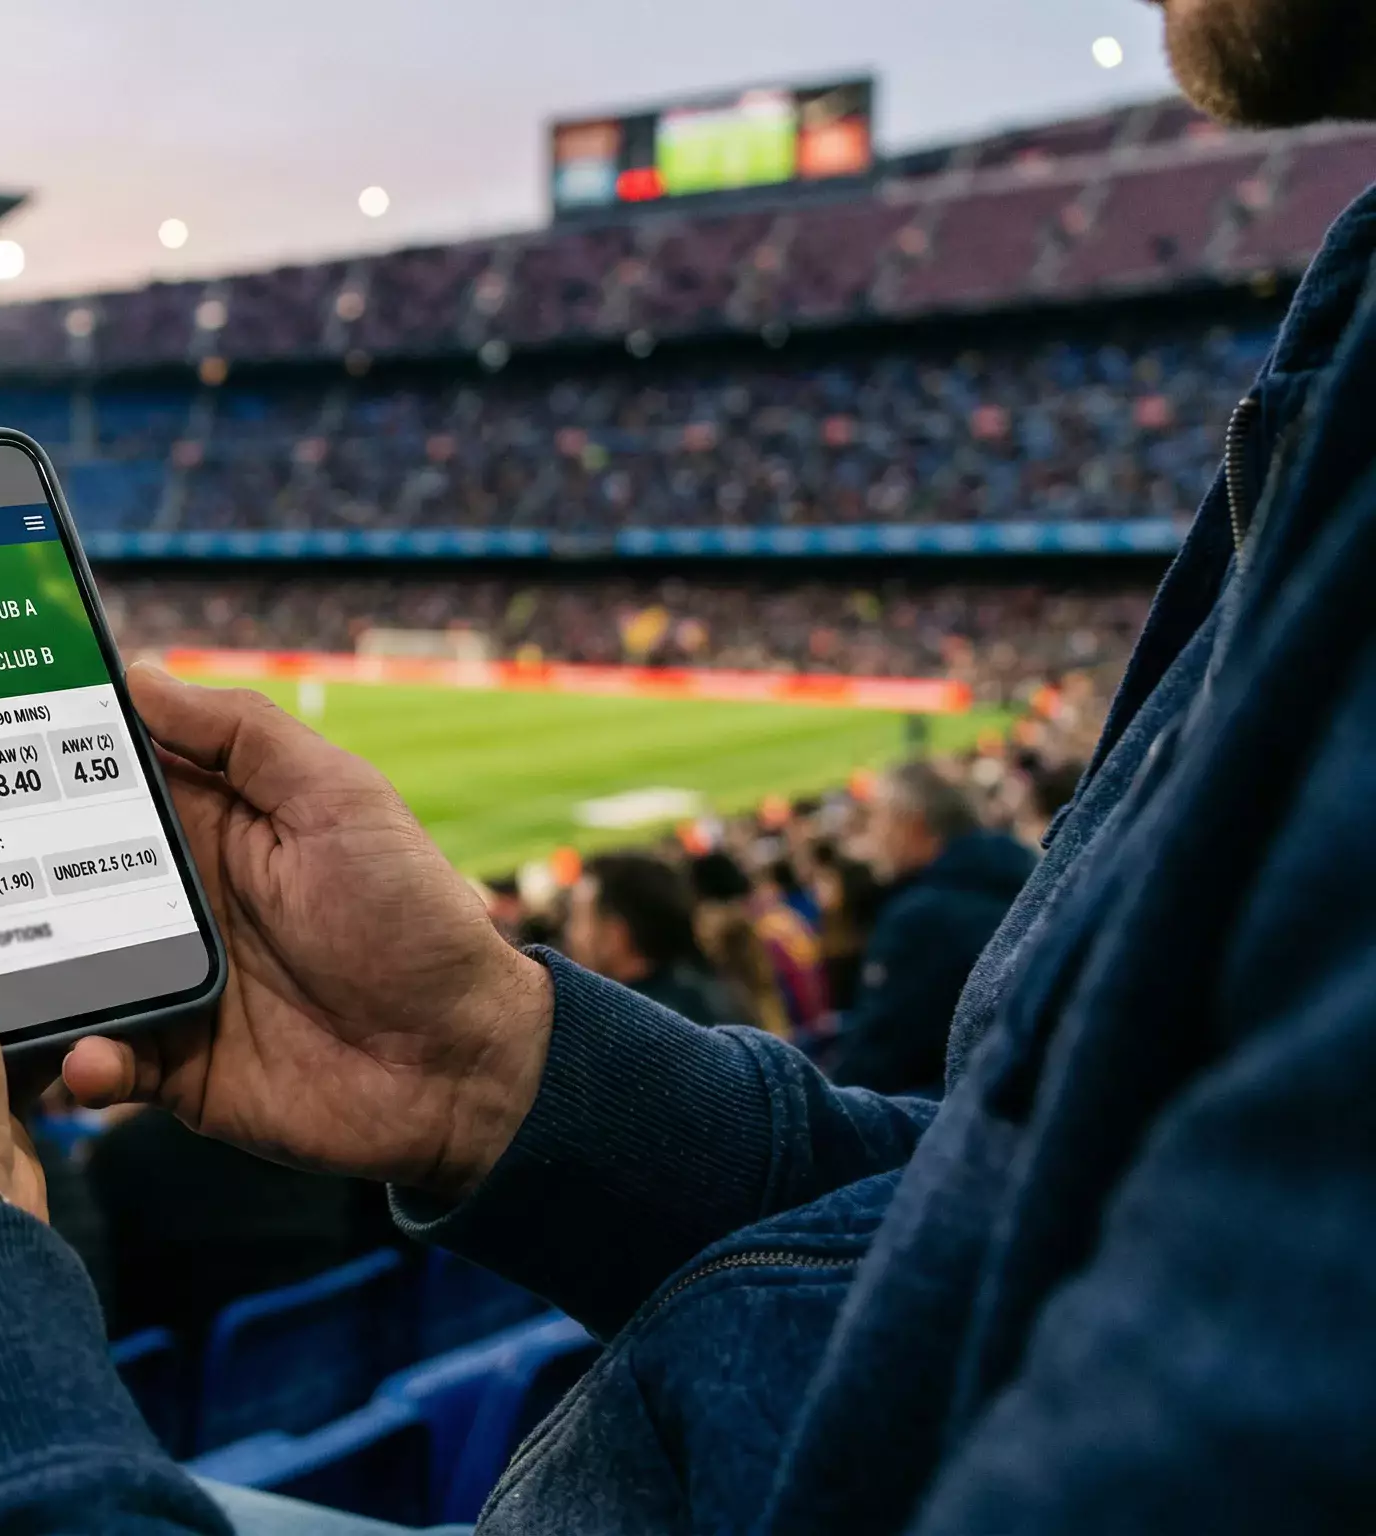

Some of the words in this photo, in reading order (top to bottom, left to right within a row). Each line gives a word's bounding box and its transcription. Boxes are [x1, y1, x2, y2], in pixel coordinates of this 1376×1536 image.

[26, 599, 37, 616] A
[40, 647, 54, 664] B
[14, 706, 50, 722] MINS)
[62, 737, 93, 754] AWAY
[97, 734, 113, 750] (2)
[20, 746, 37, 763] (X)
[75, 757, 119, 783] 4.50
[54, 861, 97, 880] UNDER
[99, 856, 118, 872] 2.5
[121, 849, 156, 871] (2.10)
